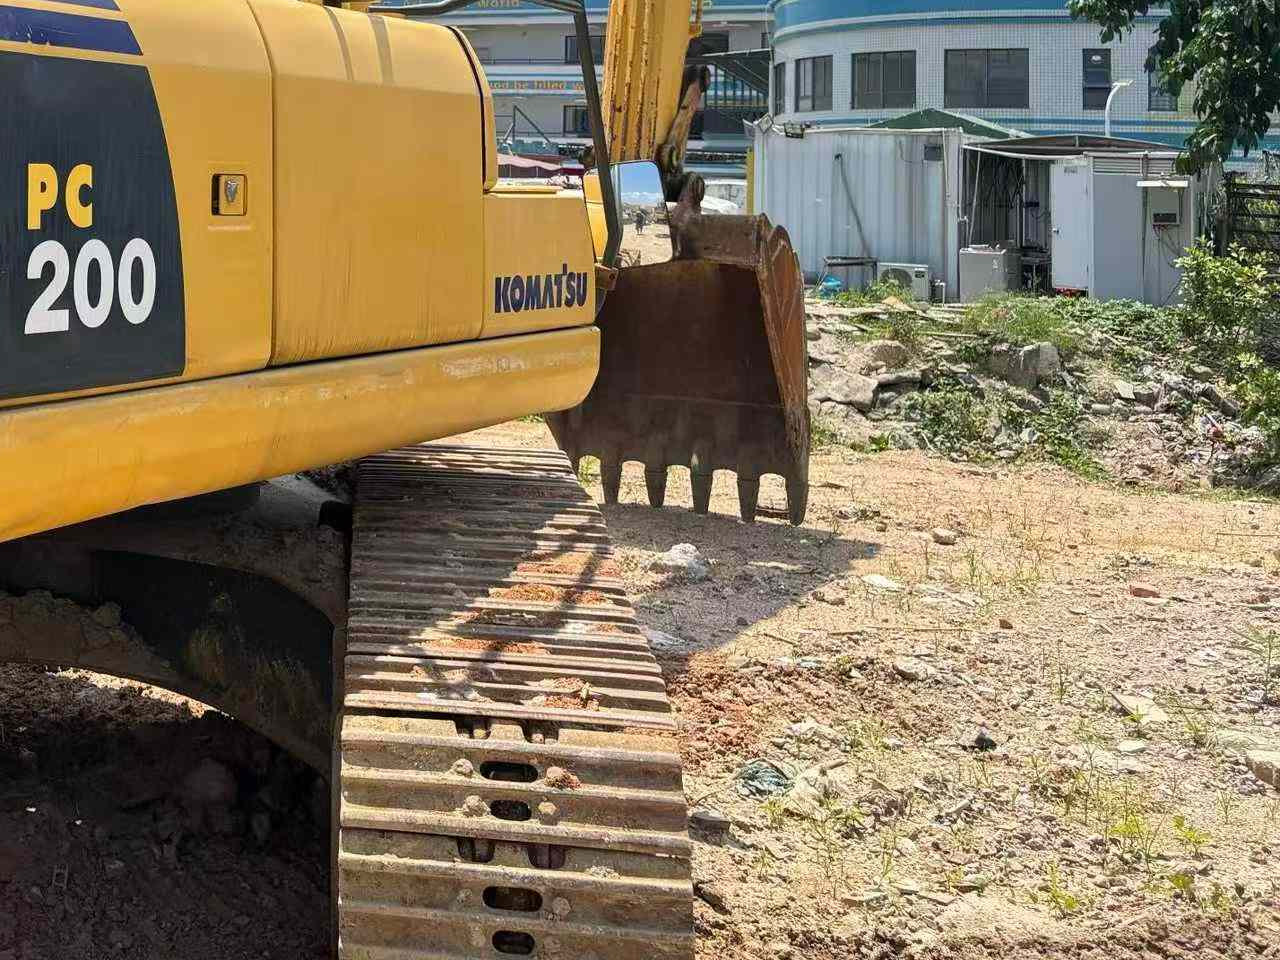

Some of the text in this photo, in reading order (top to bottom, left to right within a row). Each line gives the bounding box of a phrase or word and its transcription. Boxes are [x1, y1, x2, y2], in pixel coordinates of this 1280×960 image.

[27, 162, 94, 231] PC
[24, 237, 157, 335] 200
[494, 263, 588, 314] KOMATSU
